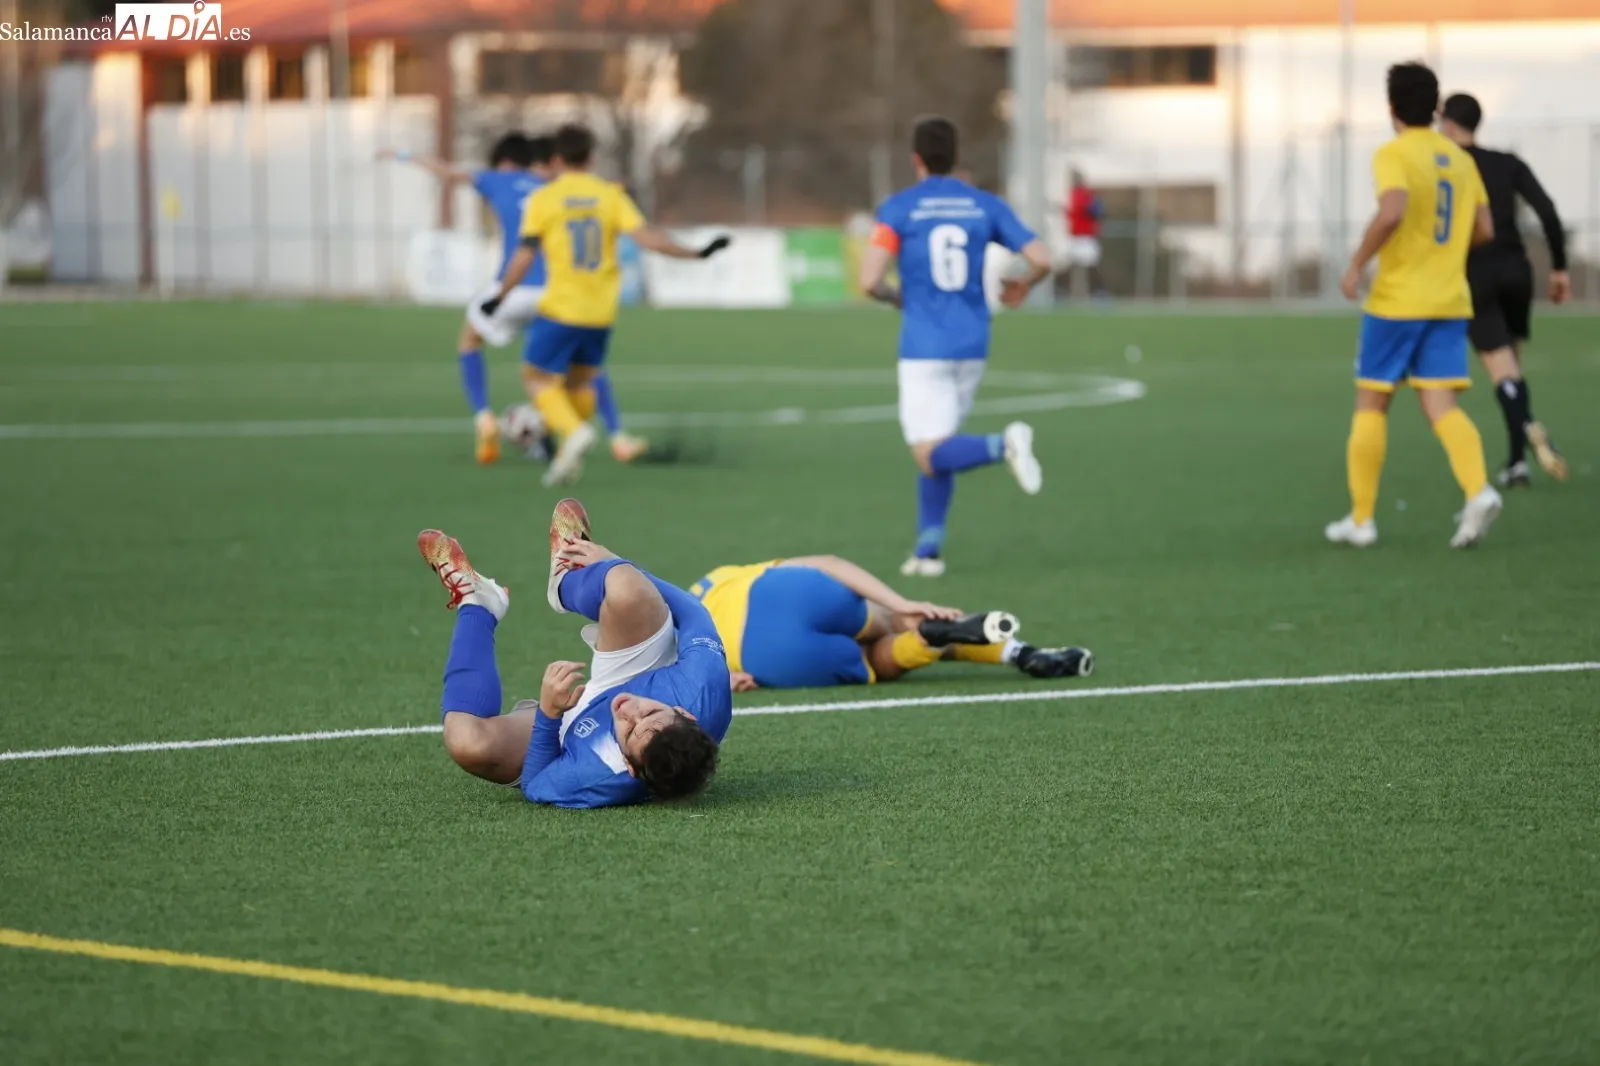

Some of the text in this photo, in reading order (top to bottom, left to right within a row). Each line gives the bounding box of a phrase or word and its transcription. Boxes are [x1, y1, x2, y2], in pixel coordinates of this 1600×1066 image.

[1434, 179, 1454, 244] 9
[567, 217, 603, 272] 10
[928, 224, 969, 292] 6
